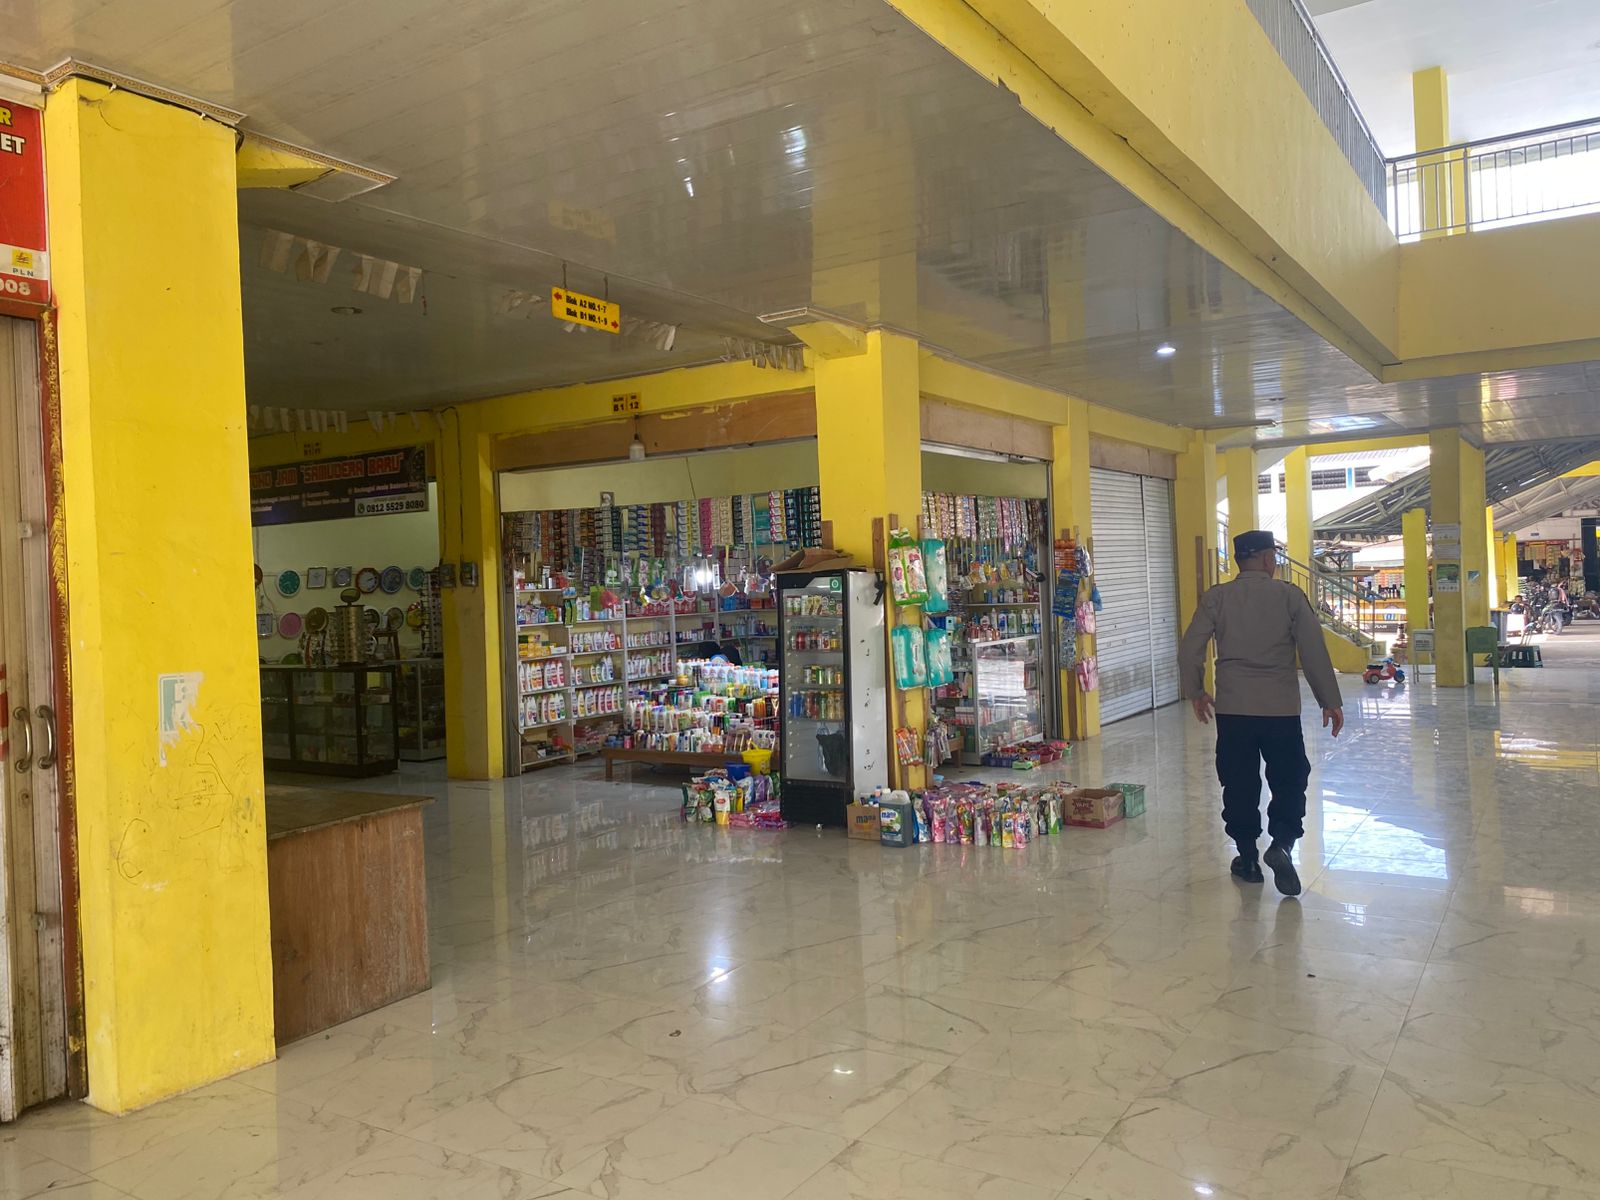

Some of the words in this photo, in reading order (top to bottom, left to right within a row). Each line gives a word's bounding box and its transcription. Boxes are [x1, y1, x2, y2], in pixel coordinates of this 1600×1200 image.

[12, 268, 34, 277] PLN
[580, 299, 587, 308] A2
[629, 401, 639, 409] 12
